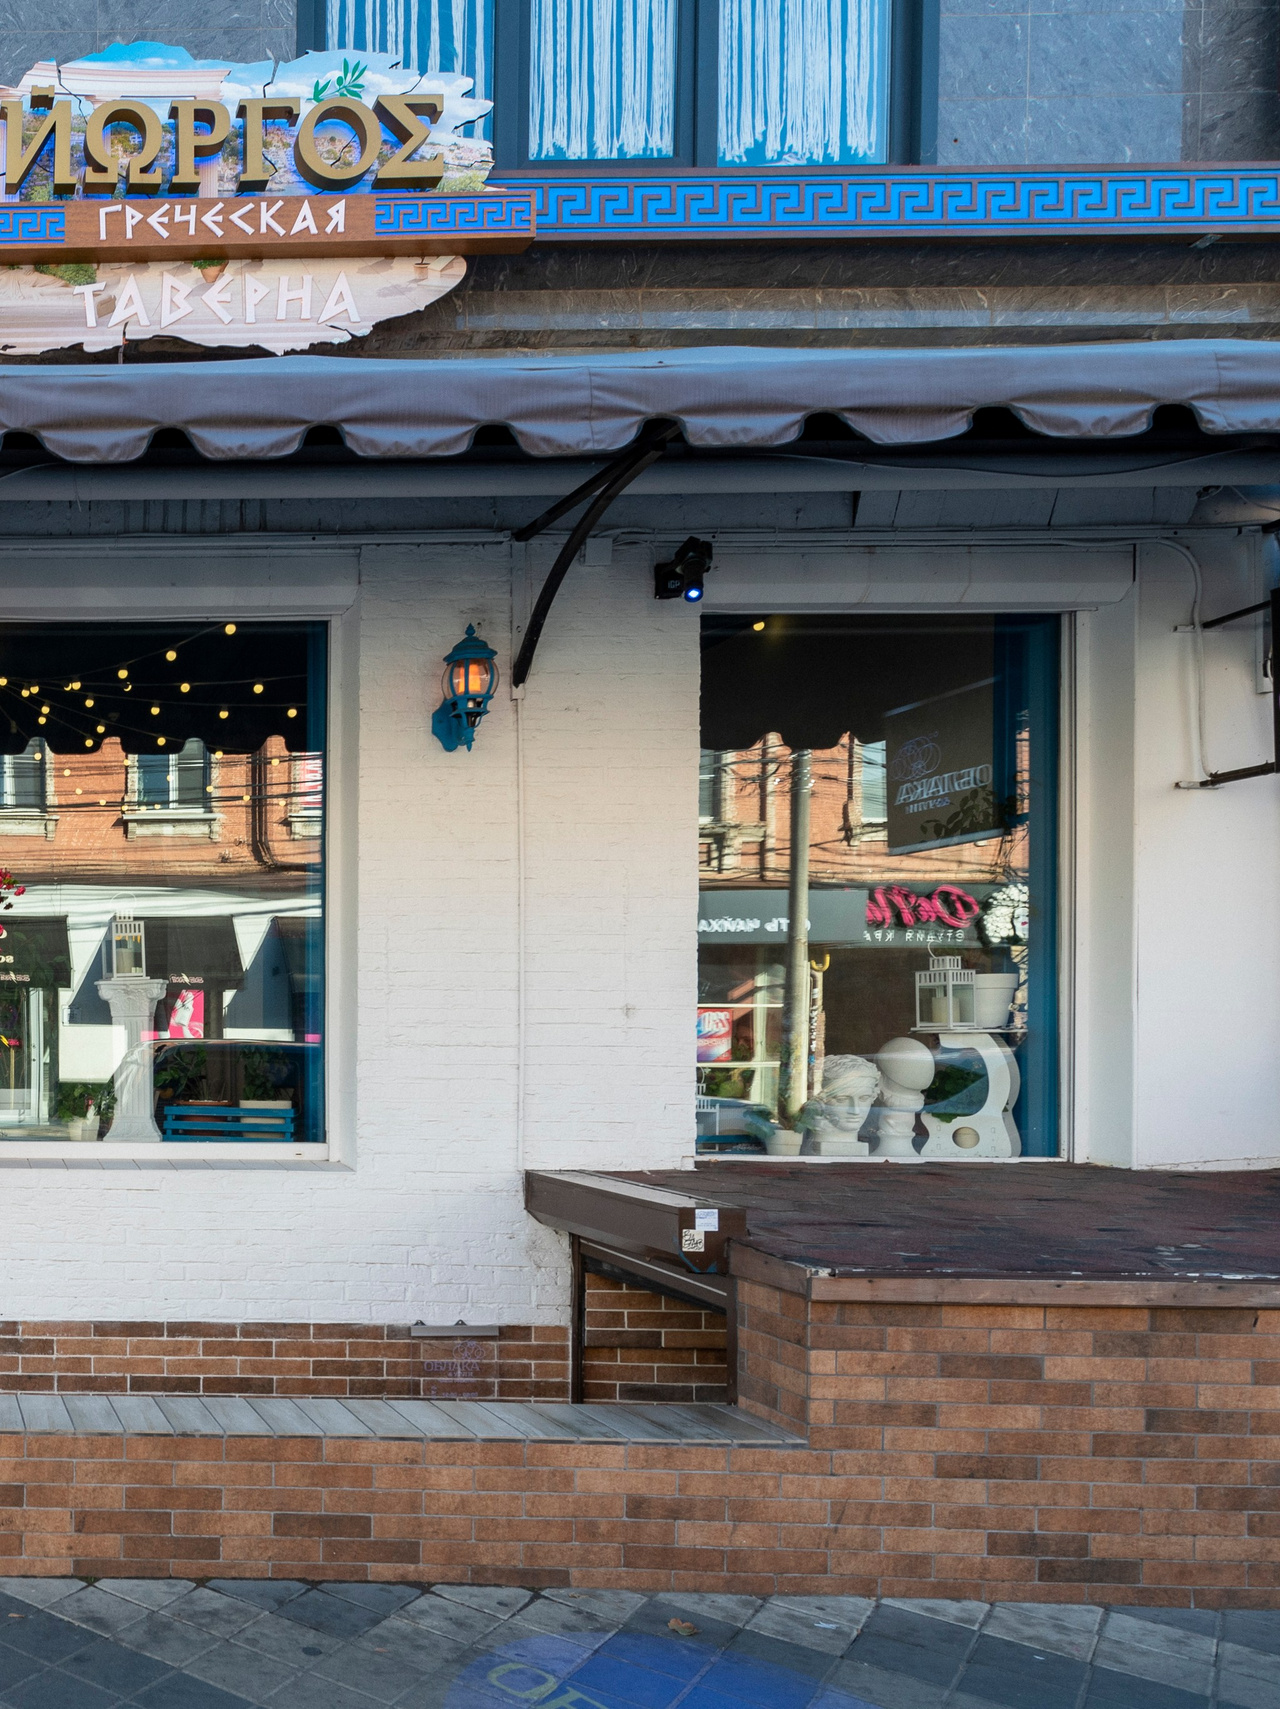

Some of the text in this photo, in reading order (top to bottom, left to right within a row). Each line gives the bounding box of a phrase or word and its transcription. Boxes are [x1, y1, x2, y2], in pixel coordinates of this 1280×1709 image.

[98, 198, 348, 241] ГРЕЧЕСКАЯ
[73, 269, 362, 330] ТАВЕРНА
[423, 1361, 481, 1372] ОБЛАКА
